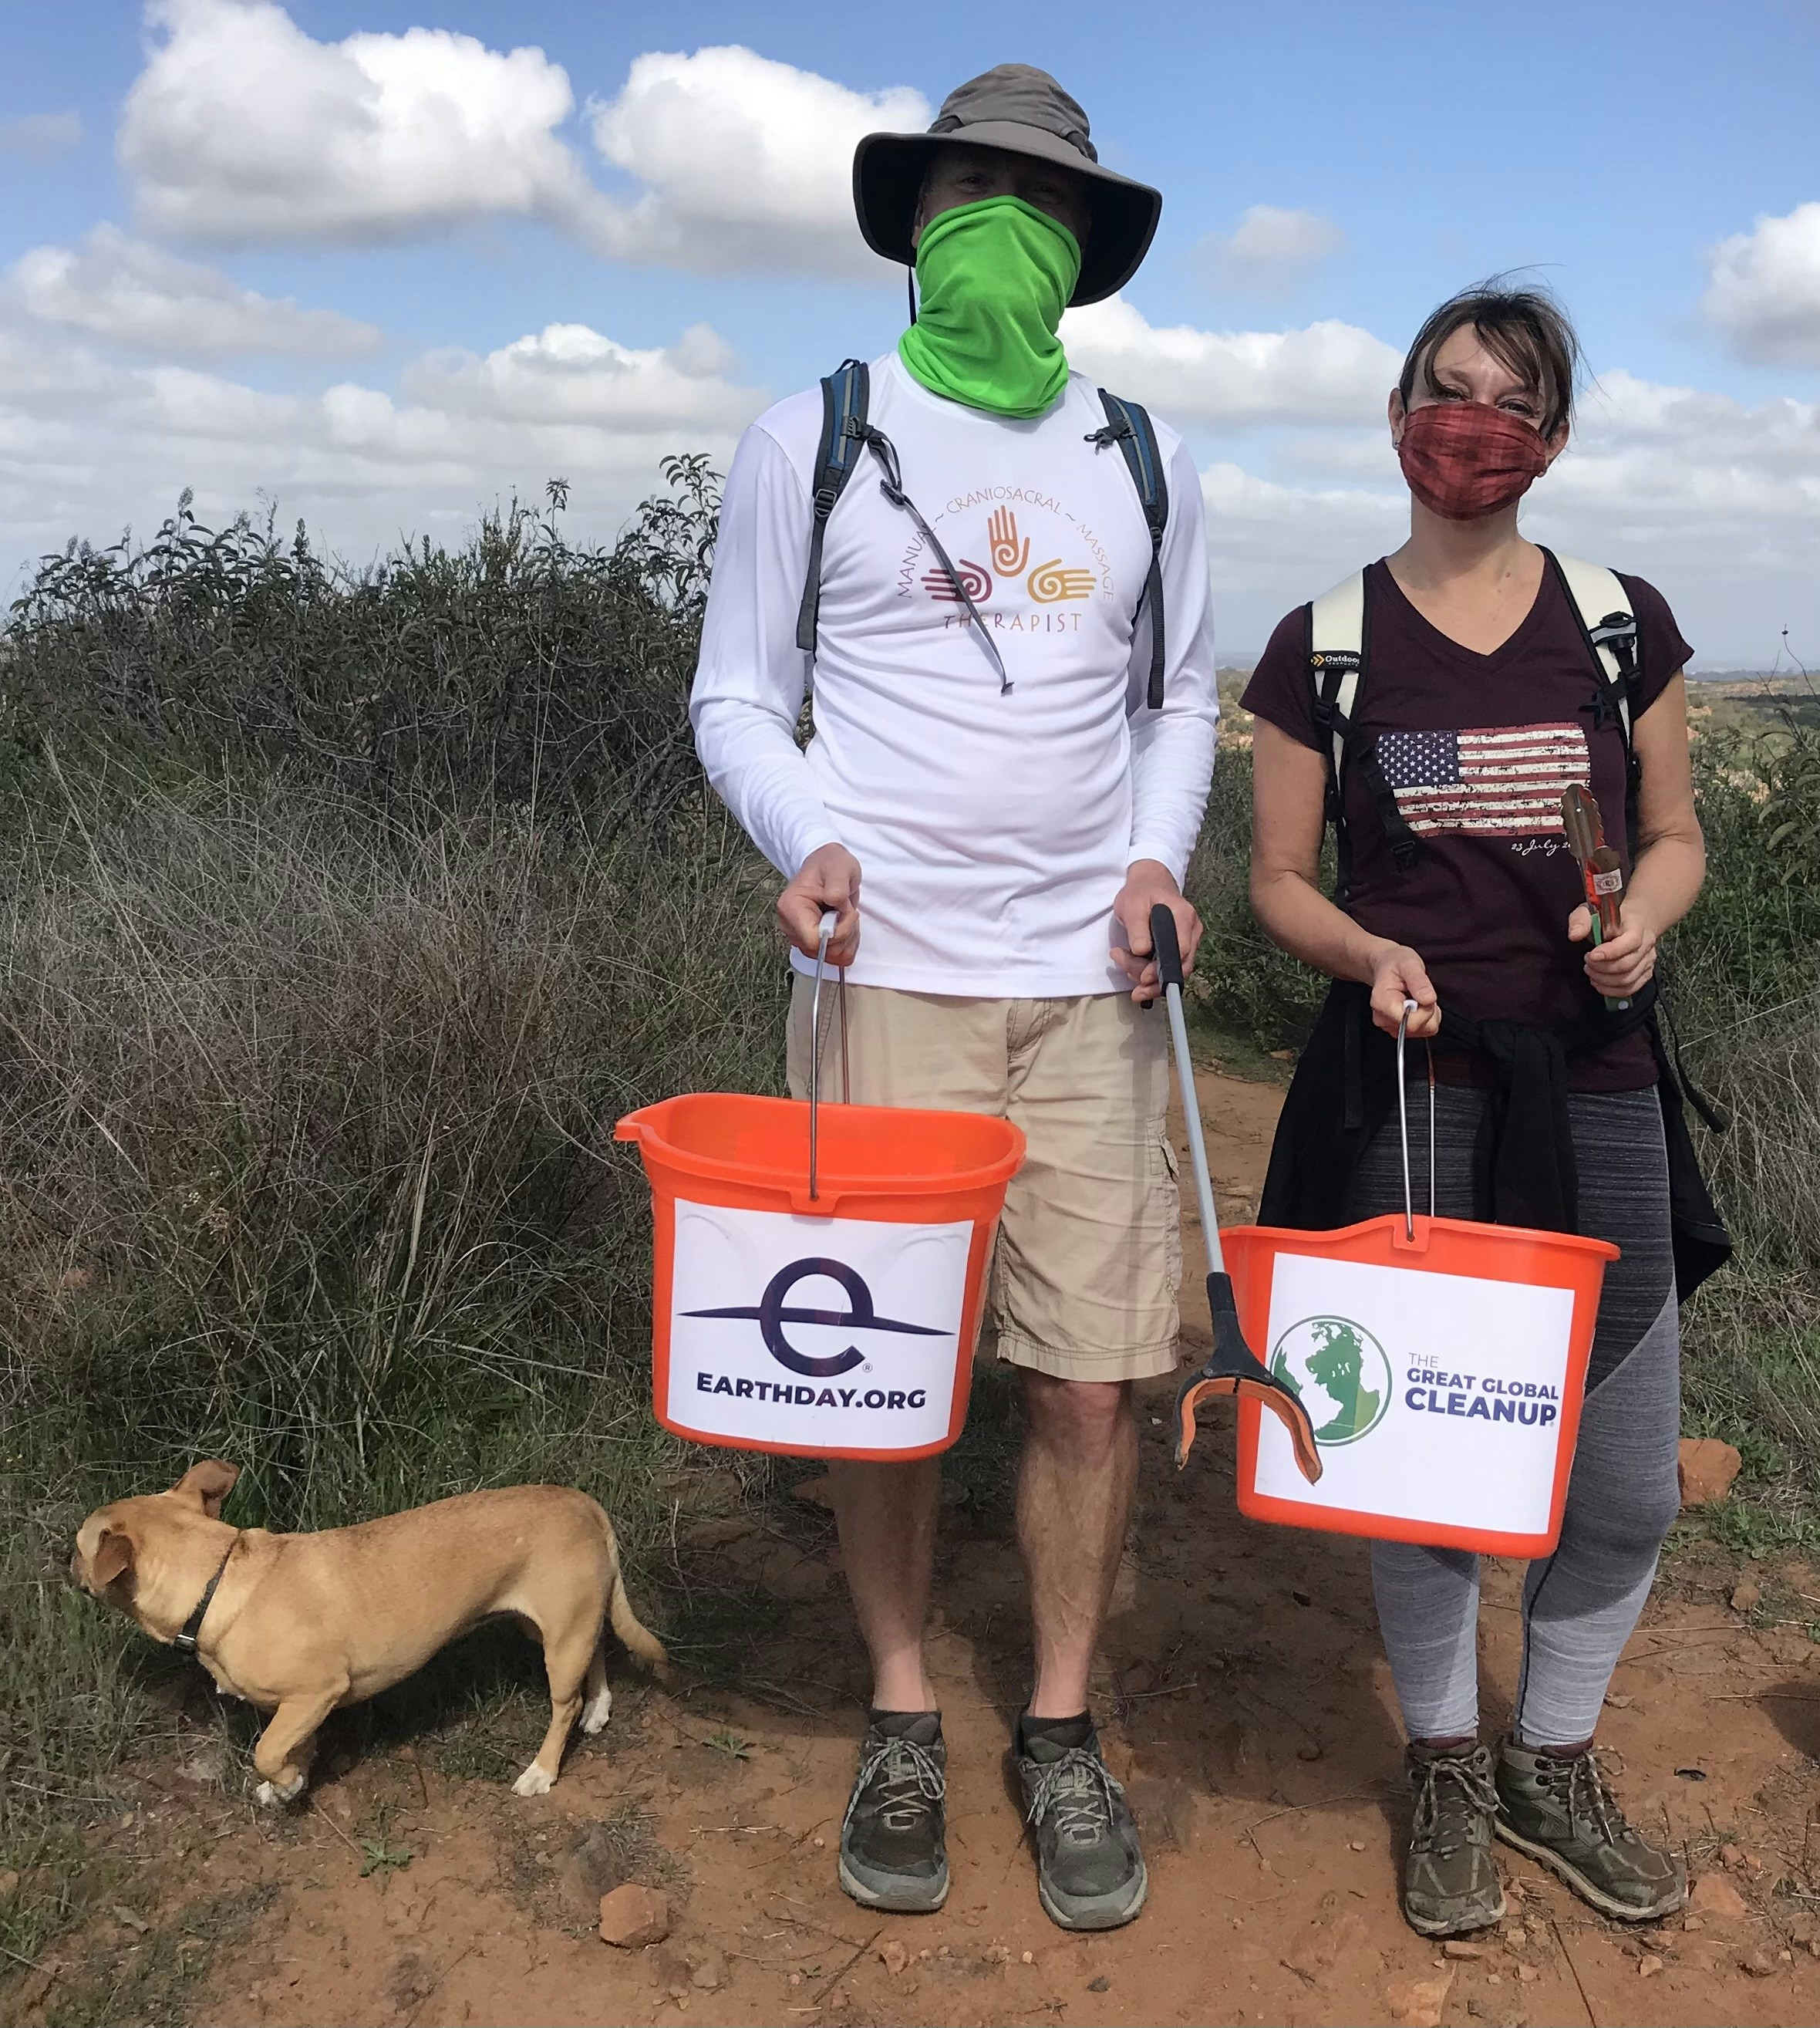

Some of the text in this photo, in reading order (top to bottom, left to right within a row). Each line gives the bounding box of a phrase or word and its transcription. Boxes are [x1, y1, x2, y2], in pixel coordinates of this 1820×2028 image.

[946, 486, 1060, 515] CRANIOSACRAL
[1076, 524, 1114, 602] MASSAGE
[1511, 842, 1523, 852] 23
[1521, 839, 1560, 857] July
[1408, 1352, 1439, 1368] THE
[696, 1371, 926, 1409] EARTHDAY.ORG
[1407, 1368, 1559, 1400] GREAT GLOBAL
[1405, 1387, 1557, 1426] CLEANUP
